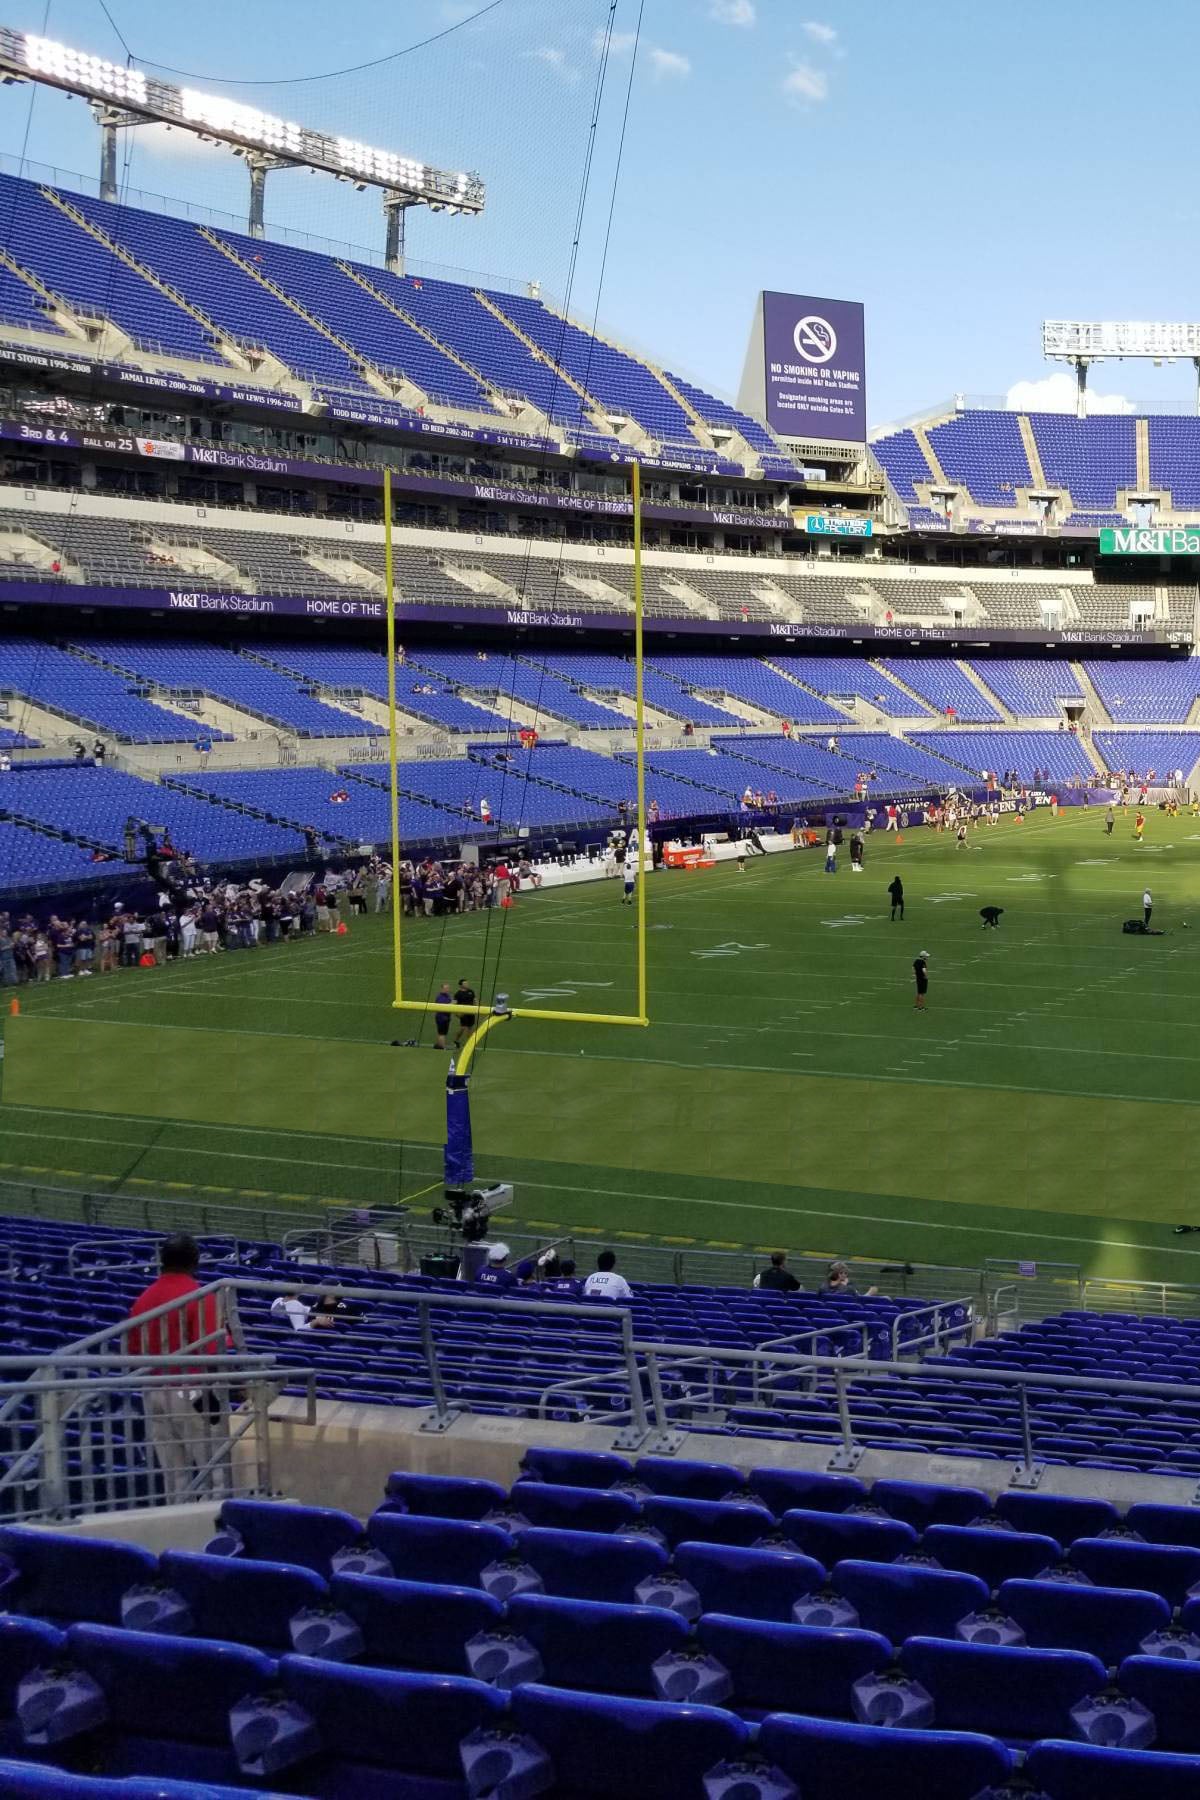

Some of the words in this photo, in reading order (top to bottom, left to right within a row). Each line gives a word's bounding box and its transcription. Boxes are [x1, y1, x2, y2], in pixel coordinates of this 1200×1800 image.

[18, 353, 48, 366] STOVER
[50, 360, 91, 374] 1996-2008
[770, 363, 782, 373] NO
[784, 364, 818, 378] SMOKING
[820, 369, 830, 378] OR
[832, 370, 860, 382] VAPING
[772, 376, 796, 384] permitted
[120, 372, 144, 384] JAMAL
[146, 376, 167, 387] LEWIS
[168, 380, 206, 394] 2000-2006
[232, 391, 245, 400] RAY
[246, 394, 265, 404] LEWIS
[266, 398, 299, 409] 1996-2012
[797, 402, 810, 410] ONLY
[333, 408, 350, 418] TODD
[350, 411, 366, 420] HEAP
[20, 426, 42, 439] 3RD
[45, 429, 56, 441] &
[60, 431, 69, 442] 4
[422, 423, 430, 431] ED
[430, 425, 444, 434] REED
[104, 440, 116, 449] ON
[118, 438, 133, 450] 25
[192, 447, 220, 464] M&T
[220, 452, 246, 467] Bank
[246, 455, 288, 472] Stadium
[662, 460, 692, 470] CHAMPIONS
[475, 486, 496, 498] M&T
[496, 489, 516, 500] Bank
[516, 492, 549, 505] Stadium
[558, 496, 582, 508] HOME
[583, 500, 595, 510] OF
[712, 512, 734, 524] M&T
[734, 514, 756, 526] Bank
[756, 516, 788, 528] Stadium
[824, 526, 867, 535] FACTORY
[1113, 530, 1170, 553] M&T
[170, 592, 201, 608] M&T
[200, 595, 230, 610] Bank
[230, 596, 274, 612] Stadium
[306, 600, 340, 614] HOME
[342, 602, 357, 614] OF
[362, 603, 382, 616] THE
[507, 612, 529, 624] M&T
[529, 613, 550, 626] Bank
[550, 614, 582, 626] Stadium
[770, 624, 792, 635] M&T
[792, 626, 814, 636] Bank
[814, 626, 847, 637] Stadium
[874, 628, 902, 638] HOME
[904, 628, 918, 638] OF
[1061, 632, 1084, 642] M&T
[1084, 632, 1106, 642] Bank
[1106, 632, 1142, 642] Stadium
